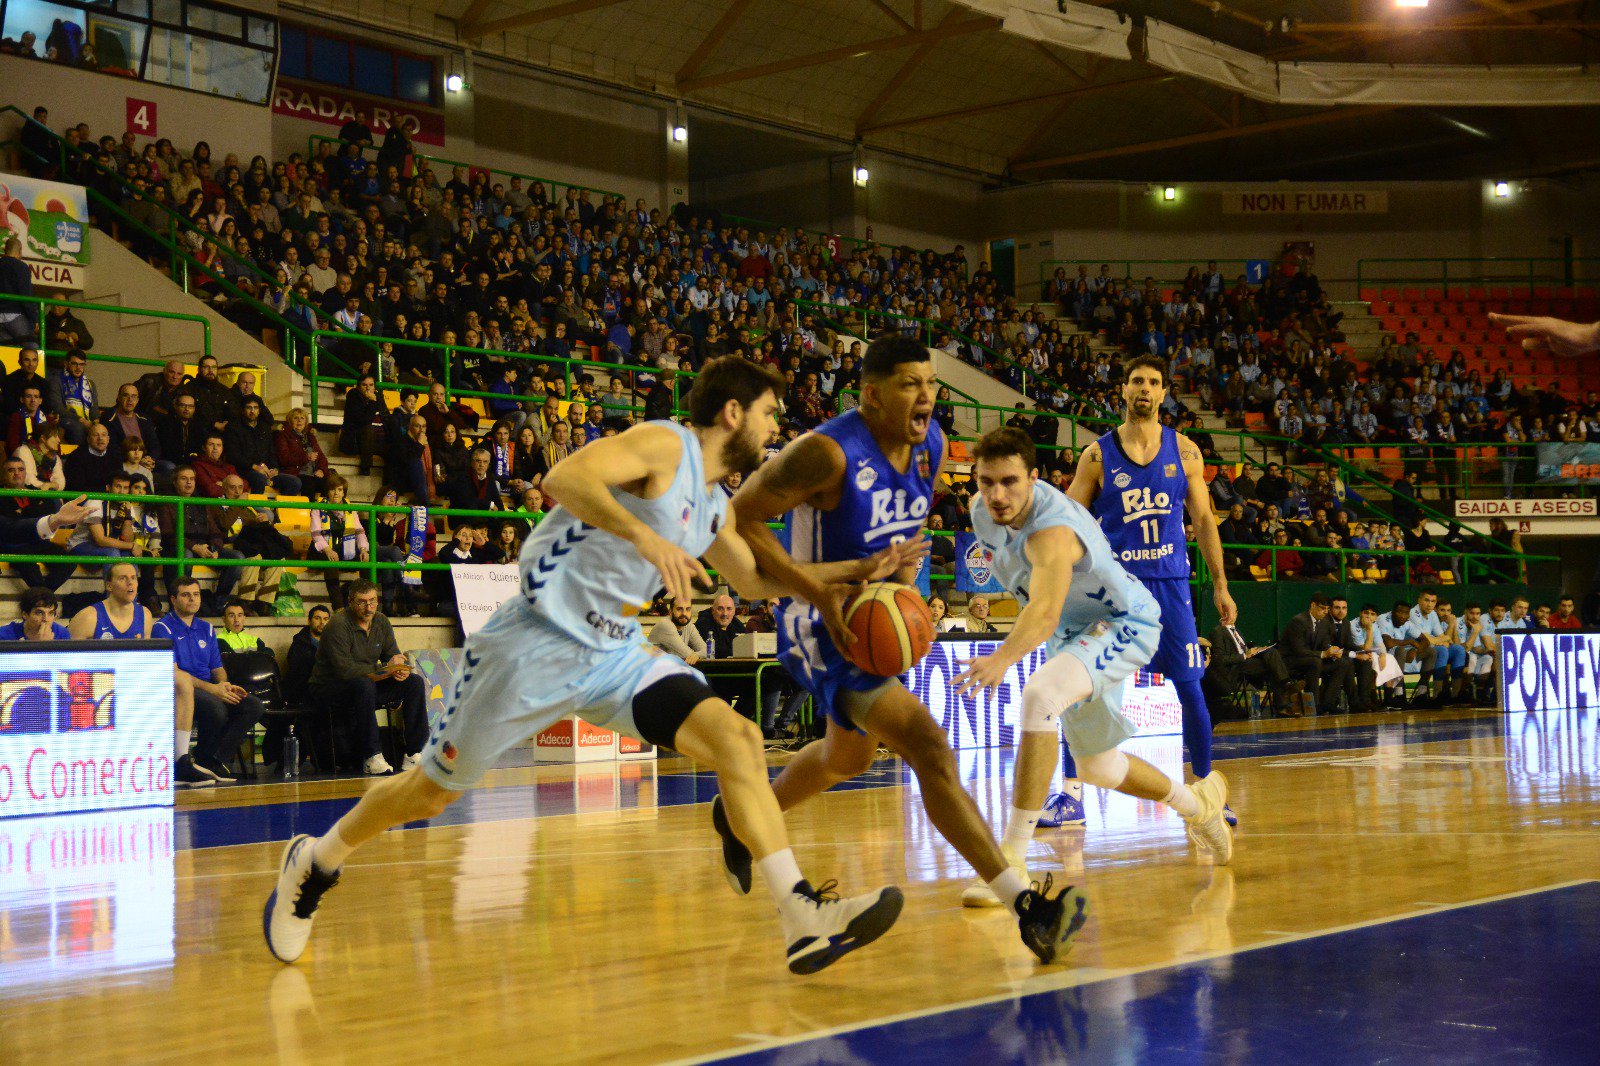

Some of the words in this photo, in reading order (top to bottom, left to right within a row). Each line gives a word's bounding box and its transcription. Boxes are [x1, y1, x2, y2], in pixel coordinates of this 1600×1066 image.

[134, 105, 149, 130] 4
[373, 107, 420, 135] RO
[1242, 194, 1285, 212] NON
[1296, 194, 1367, 212] FUMAR
[1253, 263, 1262, 280] 1
[1459, 502, 1510, 514] SAIDA
[1515, 502, 1522, 514] E
[1532, 502, 1594, 514] ASEOS
[1140, 519, 1159, 544] 11
[1121, 543, 1174, 562] OURENSE
[489, 571, 520, 583] Quiere
[468, 602, 493, 613] Equipo
[1186, 643, 1201, 668] 11
[540, 733, 571, 745] Adecco
[581, 733, 611, 745] Adecco
[25, 742, 169, 799] Comercia
